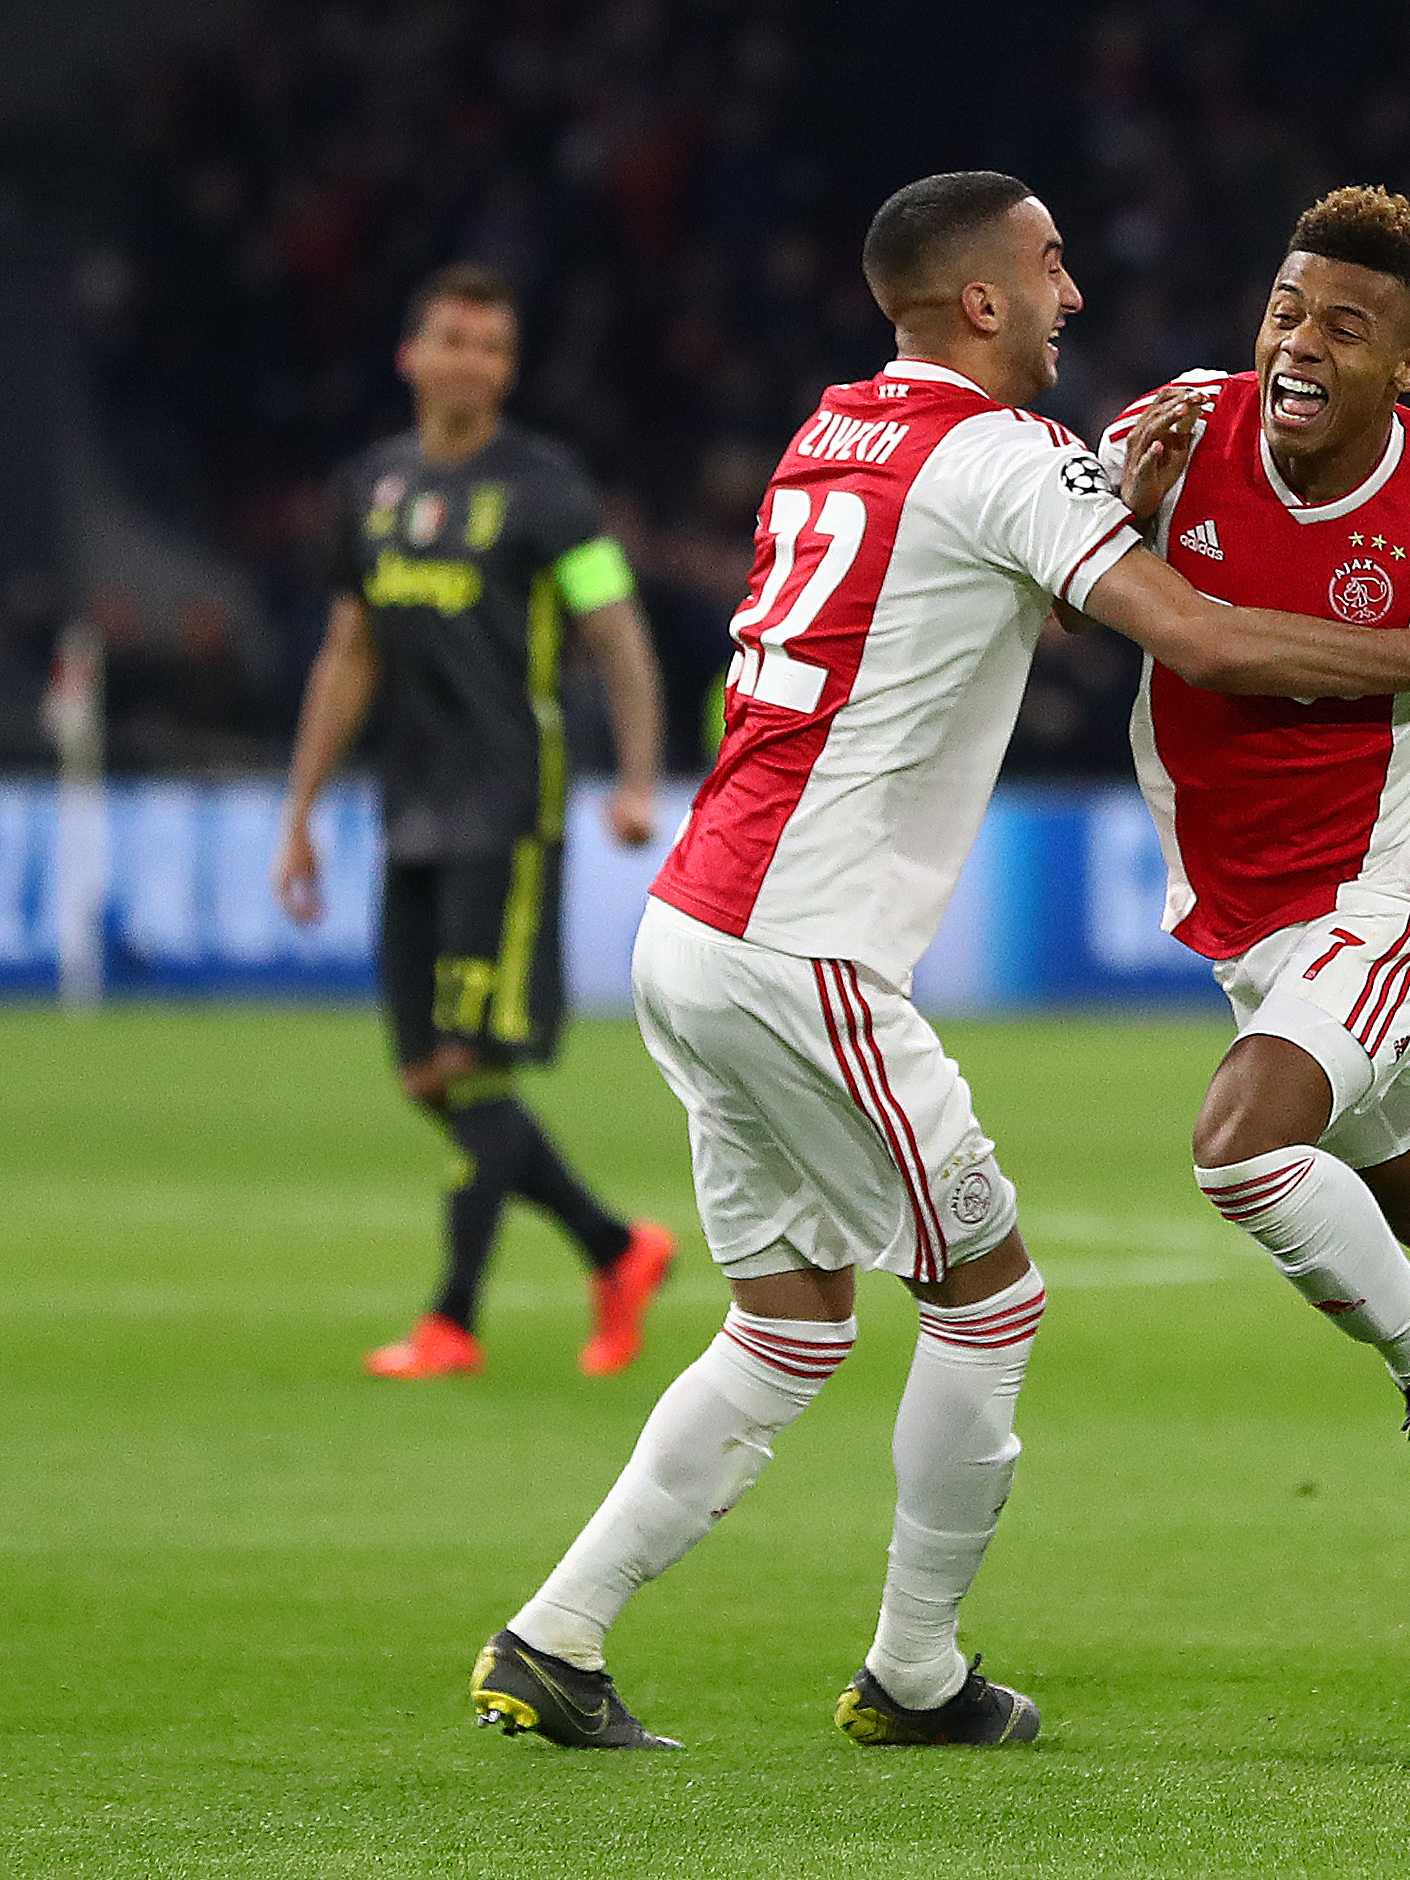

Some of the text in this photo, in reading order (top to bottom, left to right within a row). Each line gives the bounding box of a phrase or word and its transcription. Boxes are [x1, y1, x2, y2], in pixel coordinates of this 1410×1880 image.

[1180, 534, 1224, 561] adidas
[1335, 558, 1373, 580] AJAX
[1302, 927, 1366, 981] 7
